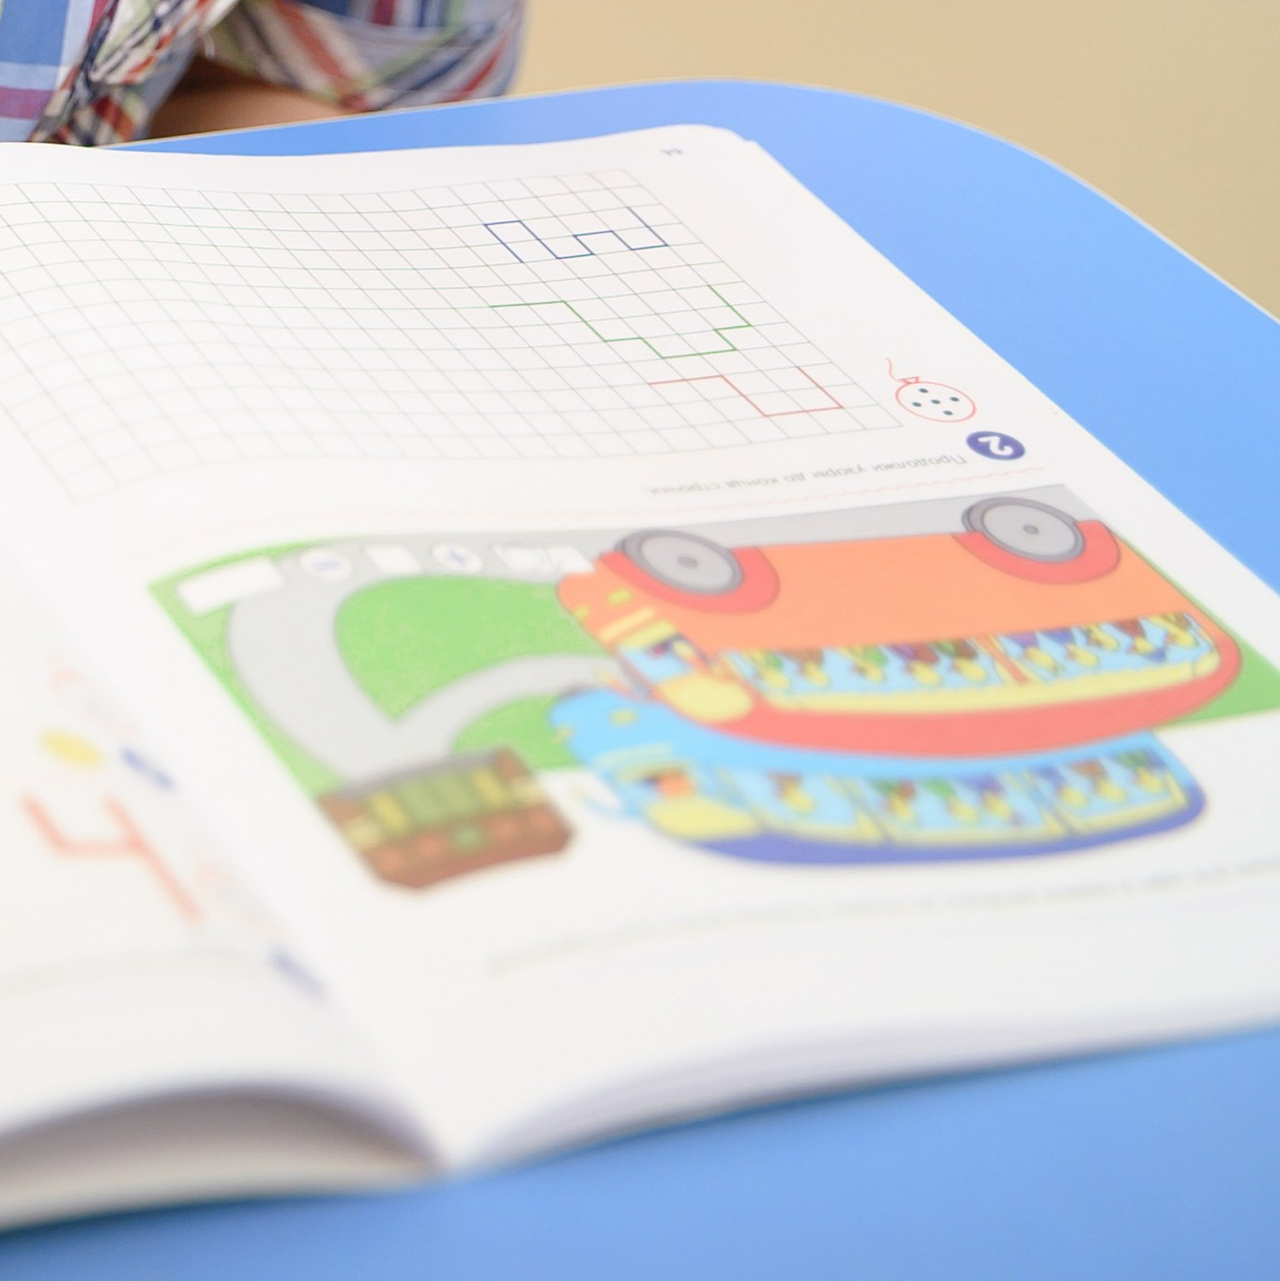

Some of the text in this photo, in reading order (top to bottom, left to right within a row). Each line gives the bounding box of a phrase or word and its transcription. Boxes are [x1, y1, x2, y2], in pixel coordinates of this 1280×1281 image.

[812, 462, 867, 479] узоры
[872, 454, 968, 473] Продолжи
[783, 471, 806, 484] до
